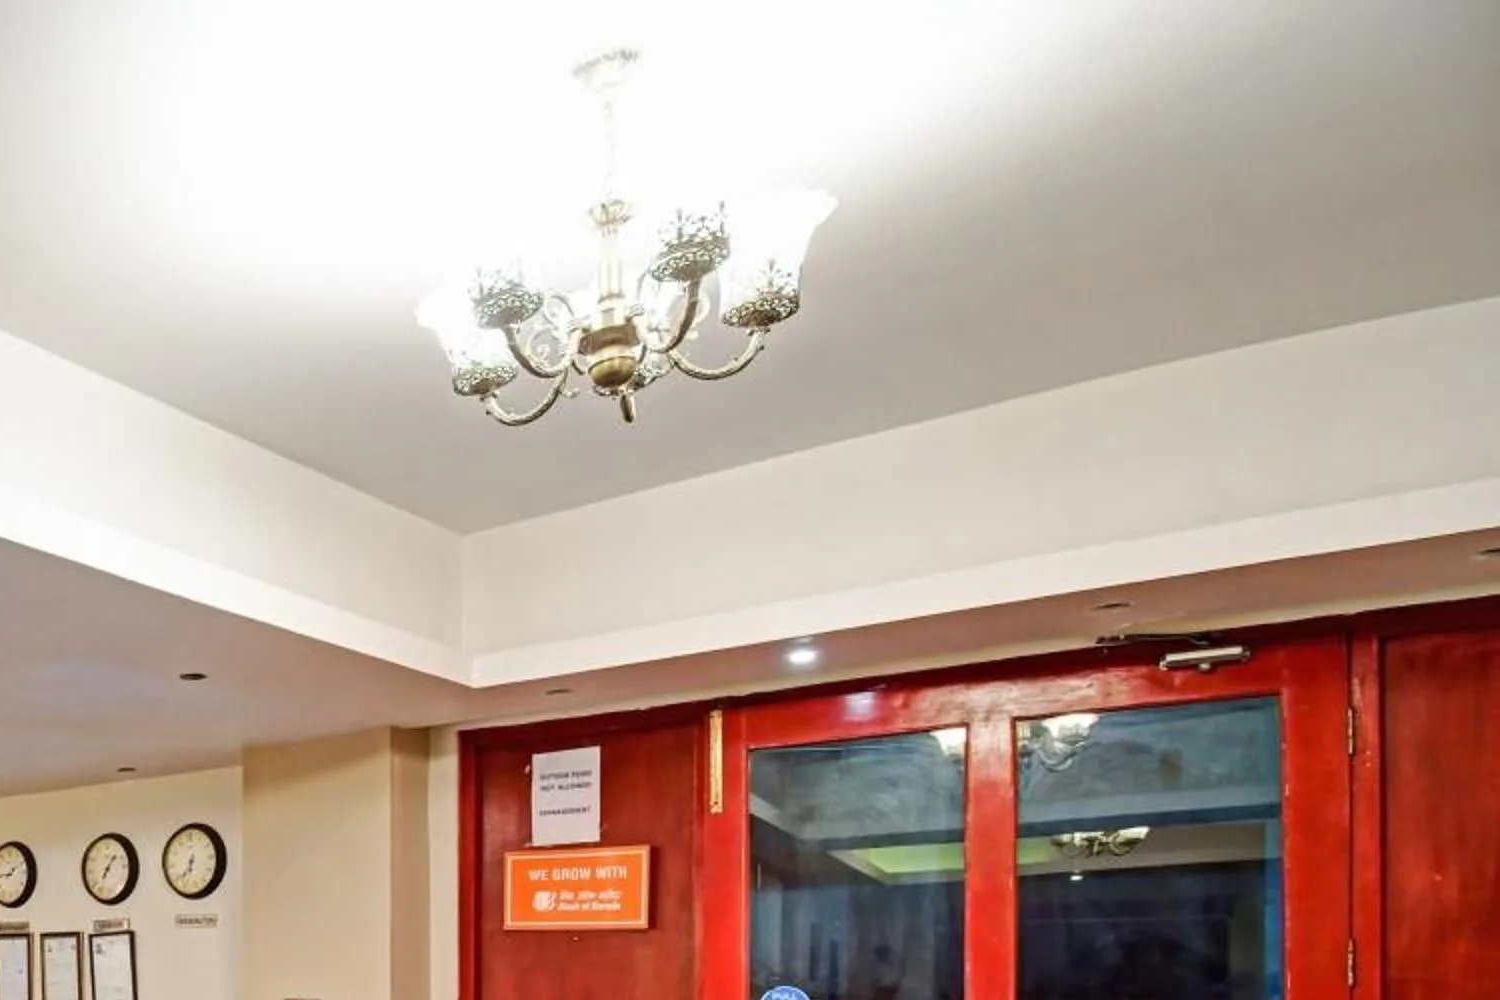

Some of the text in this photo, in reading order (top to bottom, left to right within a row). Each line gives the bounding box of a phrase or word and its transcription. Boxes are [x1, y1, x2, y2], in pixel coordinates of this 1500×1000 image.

[528, 865, 627, 881] WE GROW WITH
